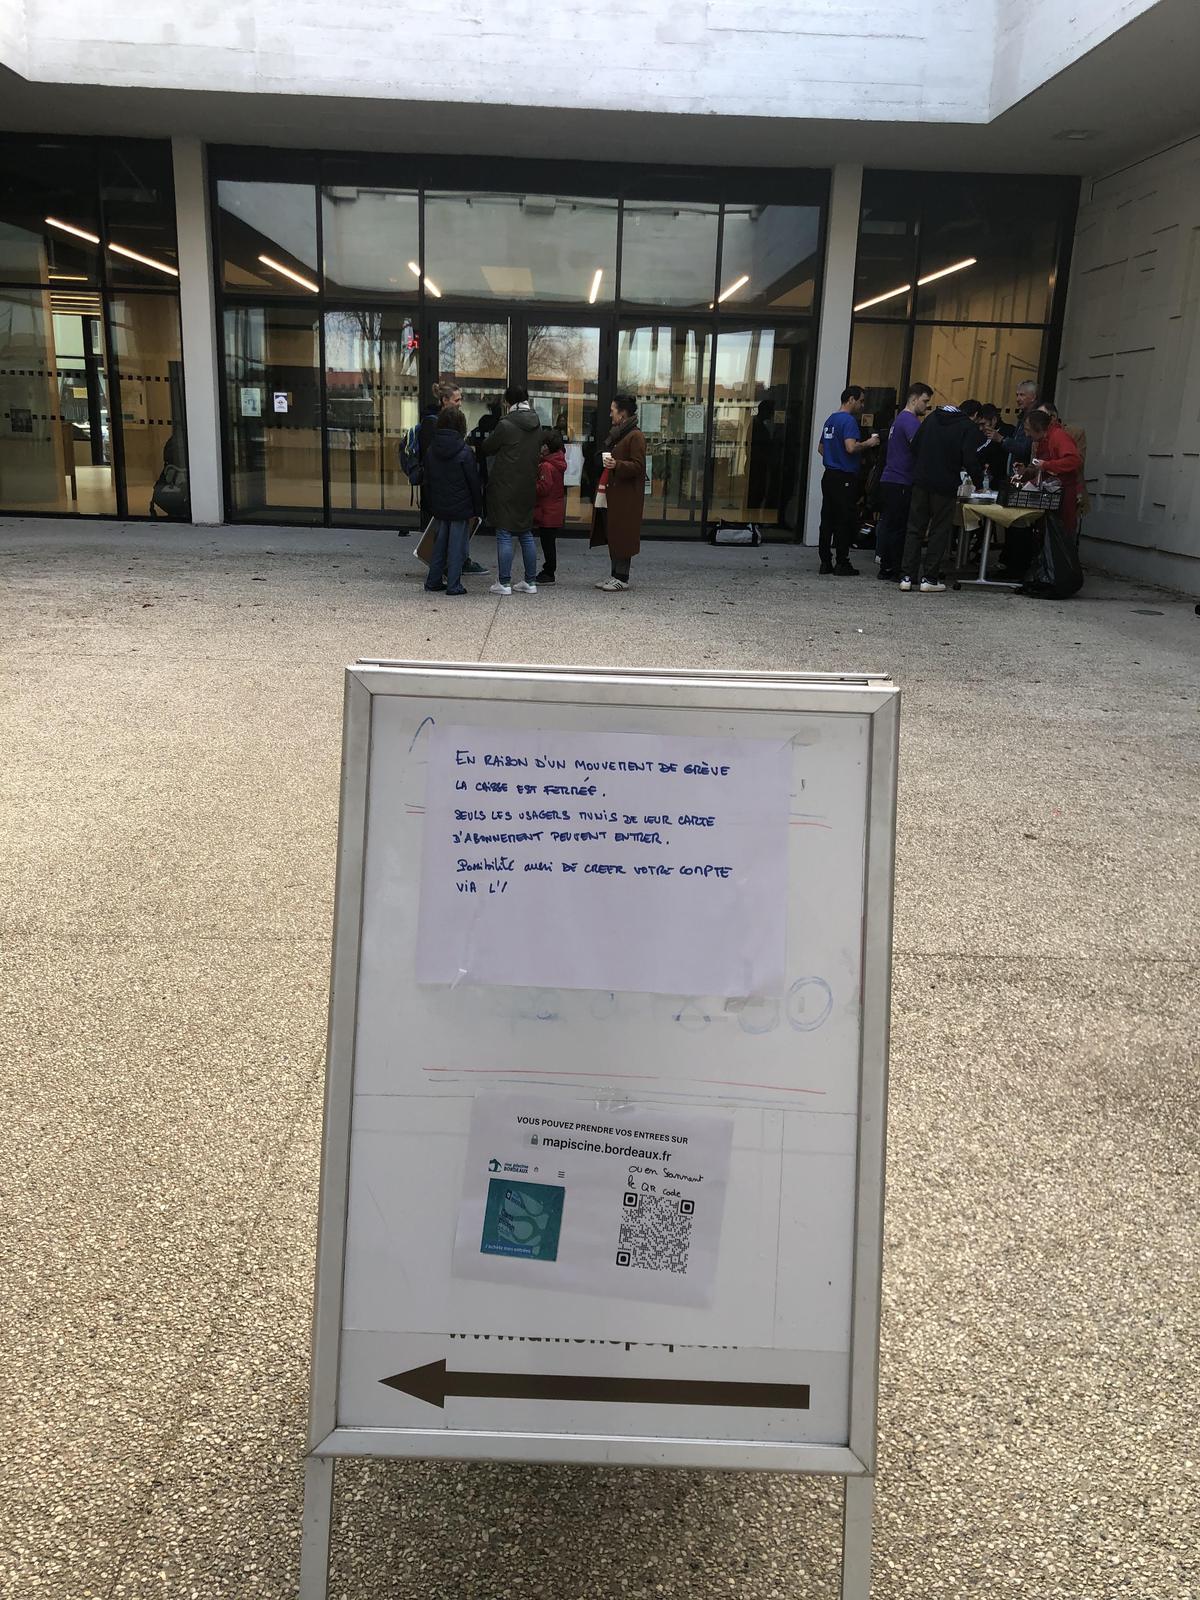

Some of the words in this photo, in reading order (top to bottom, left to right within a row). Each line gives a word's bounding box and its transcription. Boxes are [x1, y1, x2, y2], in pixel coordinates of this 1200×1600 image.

[534, 754, 566, 769] D'UN
[574, 759, 654, 772] MOUVEMENT
[657, 762, 678, 773] DE
[683, 761, 731, 776] GRÈVE
[455, 780, 467, 791] LA
[516, 784, 537, 795] EST
[454, 809, 486, 821] SEULS
[491, 810, 513, 820] LES
[518, 810, 571, 821] USAGERS
[622, 814, 638, 825] DE
[643, 815, 672, 825] LEUR
[677, 815, 716, 827] CARTE
[452, 830, 544, 844] D'ABONNEMENT
[550, 831, 607, 842] PEUVENT
[523, 861, 553, 872] aussi
[561, 862, 578, 873] DE
[584, 863, 626, 874] CREER
[633, 864, 674, 876] VOTRE
[679, 864, 733, 879] COMPTE
[516, 1116, 541, 1127] VOUS
[541, 1119, 575, 1131] POUVEZ
[575, 1123, 614, 1135] PRENDRE
[615, 1128, 633, 1138] VOS
[633, 1131, 671, 1143] ENTREES
[671, 1135, 689, 1145] SUR
[542, 1137, 672, 1161] mapiscine.bordeaux.fr
[644, 1166, 659, 1176] en
[627, 1174, 637, 1189] le
[640, 1182, 657, 1193] QR
